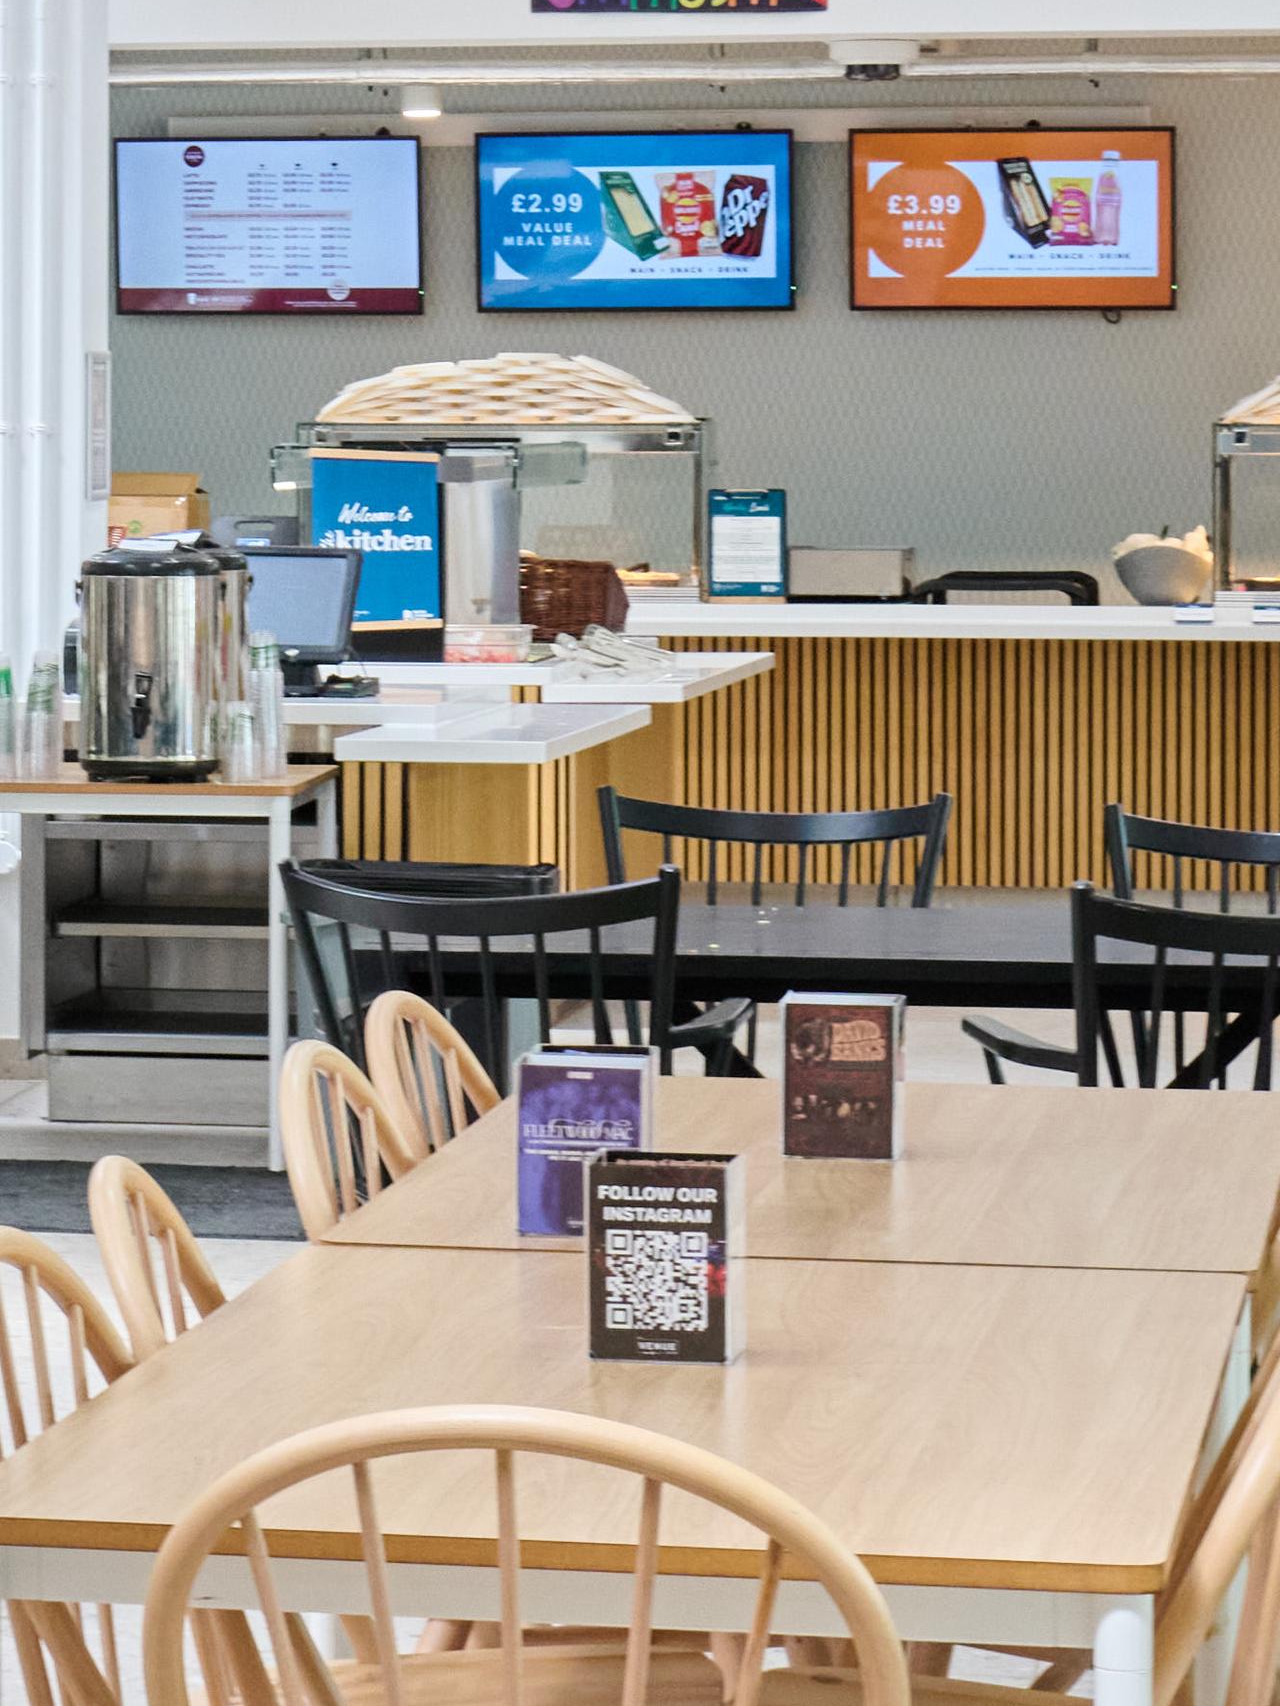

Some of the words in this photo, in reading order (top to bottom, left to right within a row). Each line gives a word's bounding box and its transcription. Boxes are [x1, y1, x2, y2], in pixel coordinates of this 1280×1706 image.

[511, 193, 583, 214] £2.99
[887, 195, 962, 215] £3.99
[521, 222, 574, 233] VALUE
[902, 220, 946, 232] MEAL
[502, 235, 545, 246] MEAL
[552, 234, 592, 246] DEAL
[903, 237, 945, 248] DEAL
[337, 502, 396, 524] Welcome
[334, 528, 433, 552] kitchen
[597, 1185, 675, 1203] FOLLOW
[676, 1187, 718, 1203] OUR
[603, 1207, 712, 1224] INSTAGRAM
